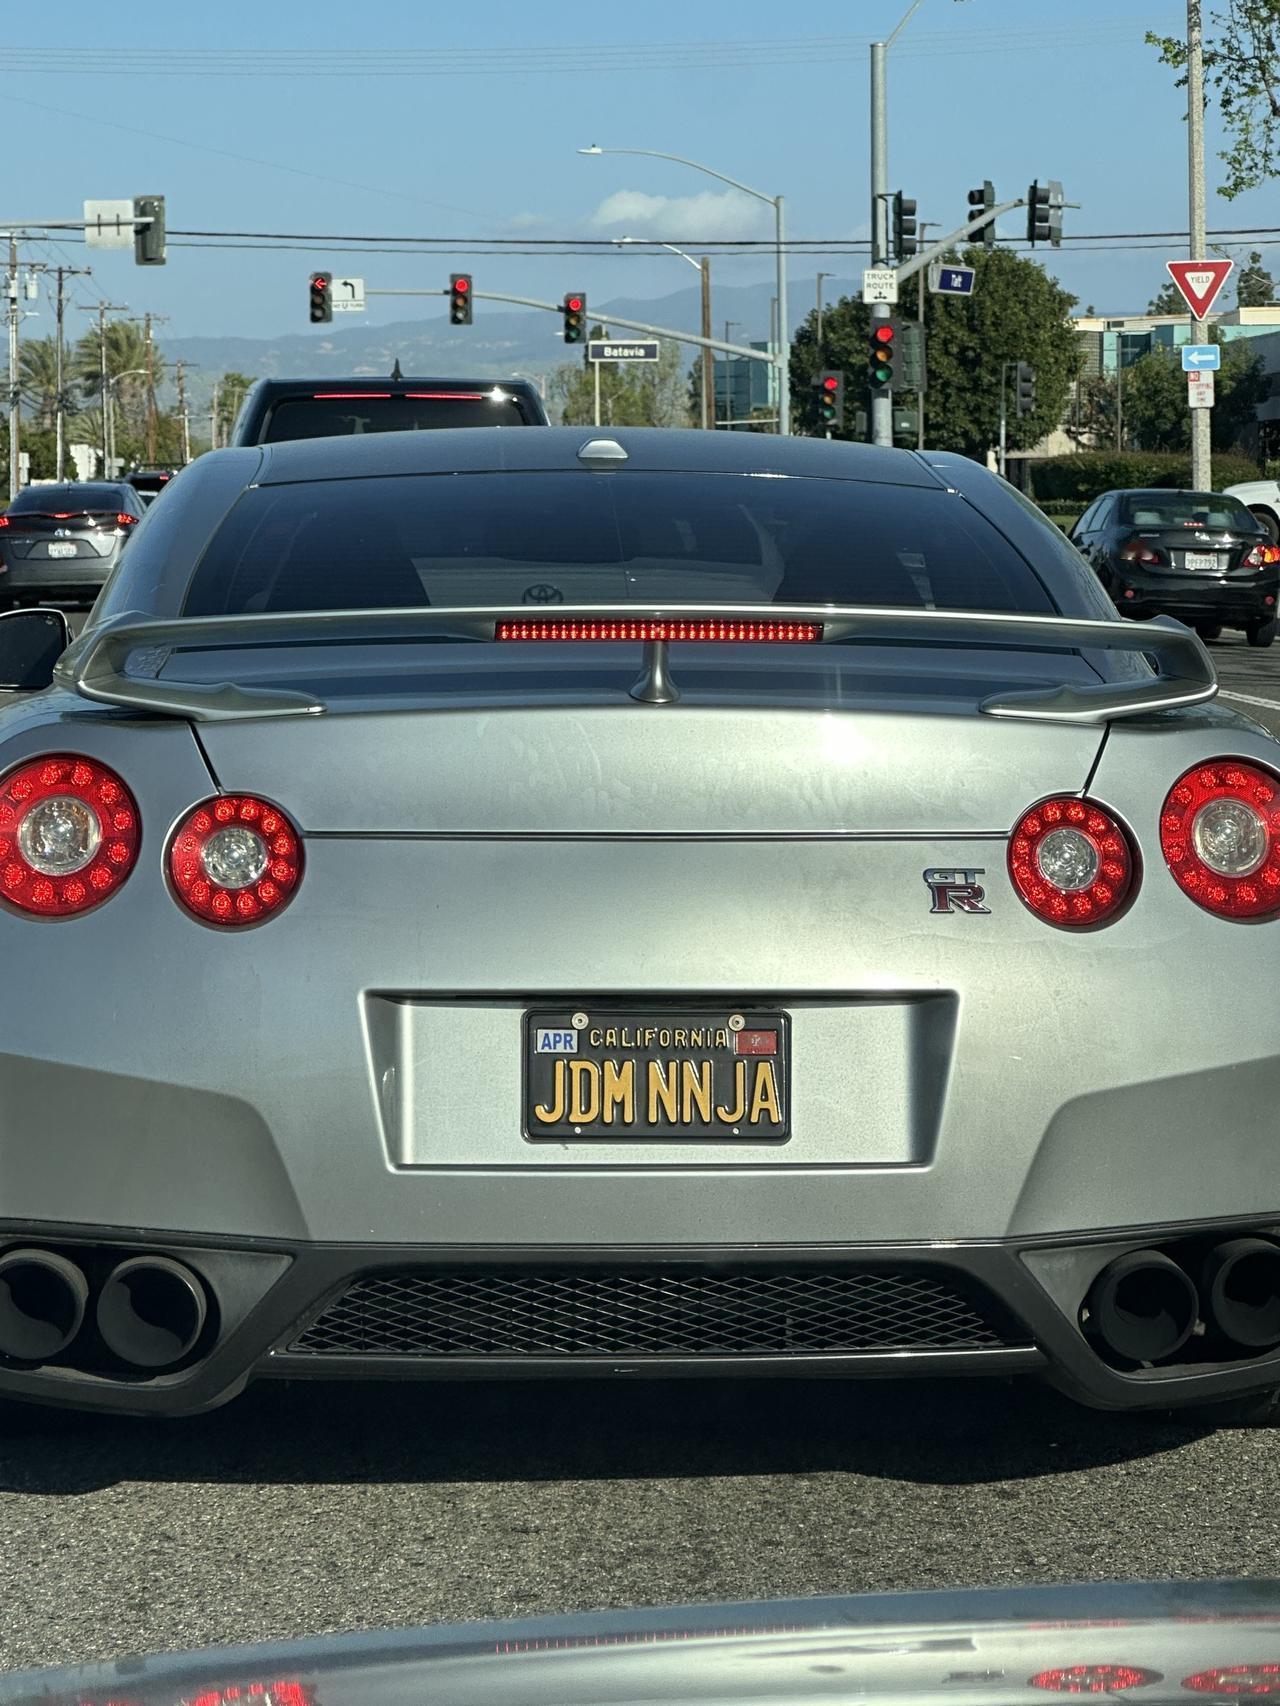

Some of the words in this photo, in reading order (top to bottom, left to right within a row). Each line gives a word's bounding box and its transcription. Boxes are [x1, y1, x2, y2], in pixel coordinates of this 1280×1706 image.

[1190, 276, 1210, 284] YIELD
[603, 346, 645, 357] Batavia
[541, 1032, 574, 1050] APR
[590, 1029, 729, 1047] CALIFORNIA
[534, 1059, 634, 1124] JDM
